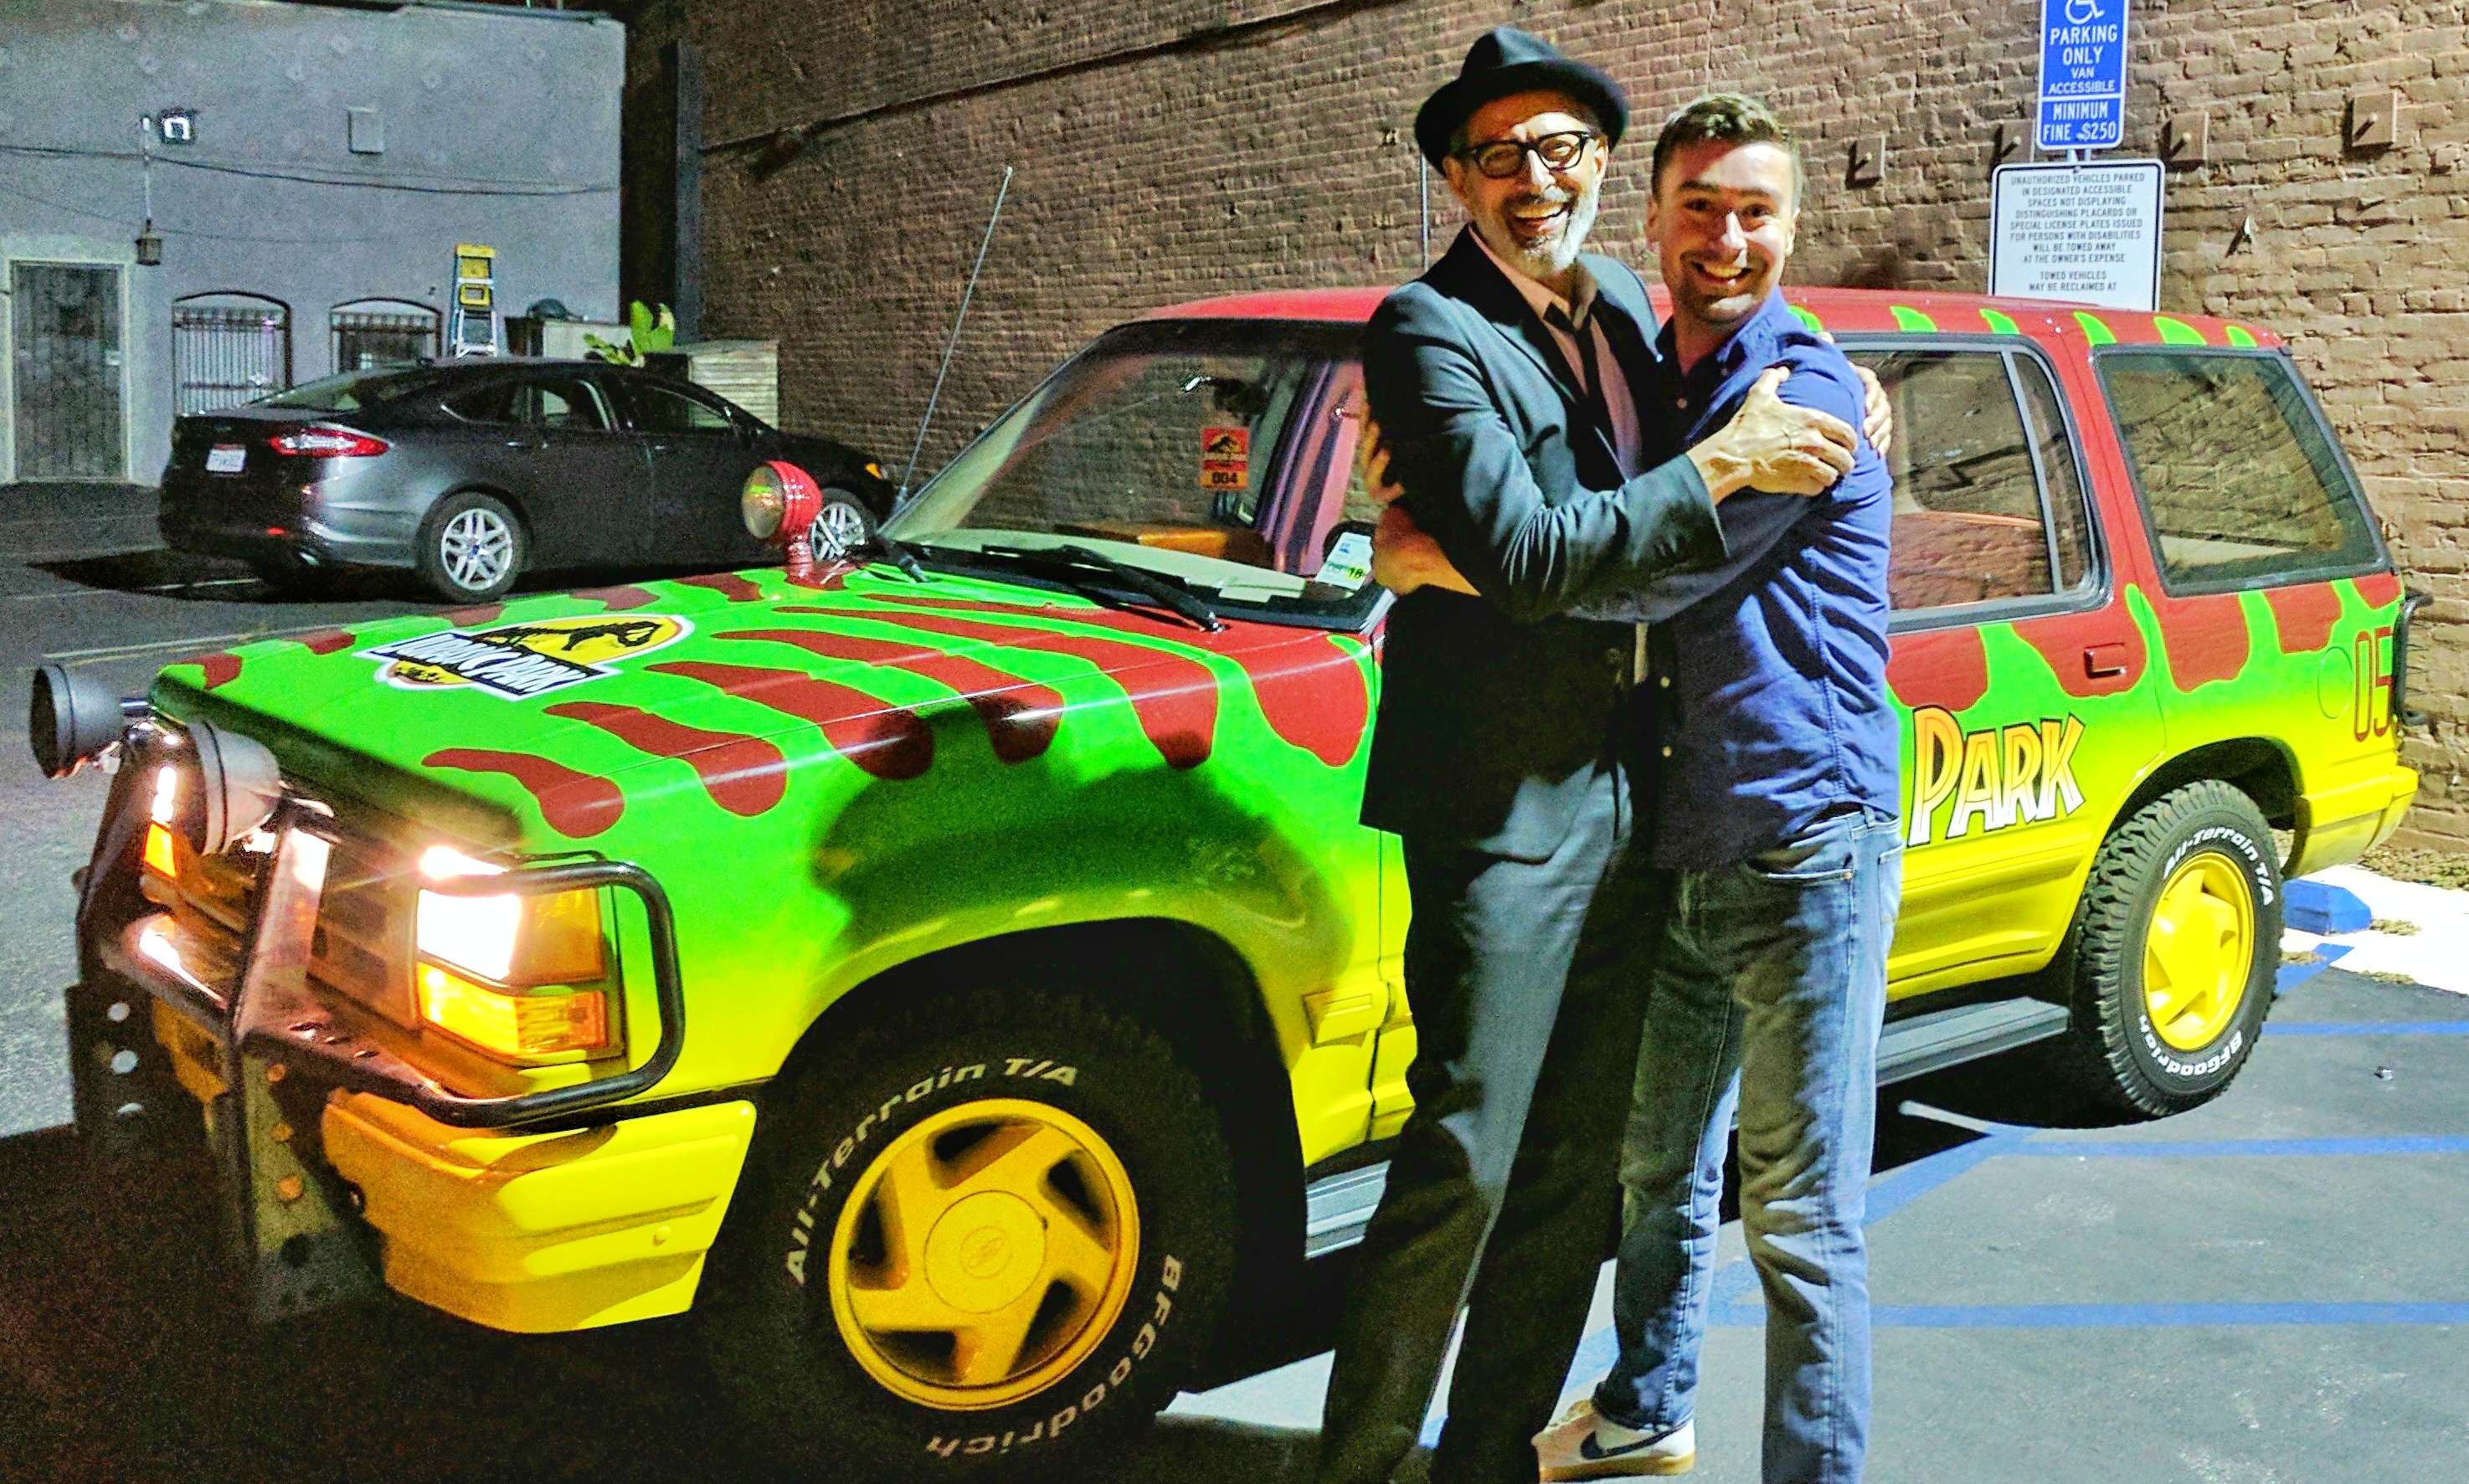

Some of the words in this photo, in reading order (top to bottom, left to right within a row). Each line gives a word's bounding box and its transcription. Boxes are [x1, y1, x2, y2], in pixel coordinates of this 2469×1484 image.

[2050, 24, 2117, 44] PARKING
[2063, 46, 2103, 65] ONLY
[2070, 66, 2094, 79] VAN
[2049, 80, 2115, 94] ACCESSIBLE
[2053, 101, 2108, 121] MINIMUM
[2044, 124, 2071, 141] FINE
[2081, 121, 2116, 141] $250
[2011, 176, 2070, 185] UNAUTHORIZED
[2073, 174, 2111, 183] VEHICLES
[2113, 173, 2145, 182] PARKED
[2032, 187, 2081, 195] DESIGNATED
[2083, 185, 2132, 194] ACCESSIBLE
[2028, 198, 2058, 208] SPACES
[2078, 197, 2127, 206] DISPLAYING
[2015, 210, 2078, 219] DISTINGUISHING
[2081, 209, 2123, 218] PLACARDS
[2010, 222, 2041, 230] SPECIAL
[2080, 220, 2110, 229] PLATES
[2112, 218, 2142, 228] ISSUED
[2028, 233, 2065, 241] PERSONS
[2067, 232, 2086, 240] WITH
[2088, 230, 2141, 239] DISABILITIES
[2034, 254, 2049, 263] THE
[2051, 254, 2086, 263] OWNER'S
[2089, 254, 2125, 263] EXPENSE
[2040, 271, 2065, 280] TOWED
[2069, 271, 2106, 280] VEHICLES
[2029, 283, 2045, 291] MAY
[2060, 283, 2105, 291] RECLAIMED
[2353, 627, 2394, 742] 05
[1907, 704, 2086, 848] PARK
[2163, 825, 2261, 880] All-Terrain
[2253, 861, 2275, 906] T/A
[2137, 1014, 2243, 1076] BFGoodrich
[786, 1062, 987, 1286] All-Terrain
[1004, 1057, 1078, 1086] T/A
[925, 1255, 1184, 1459] BFGoodrich
